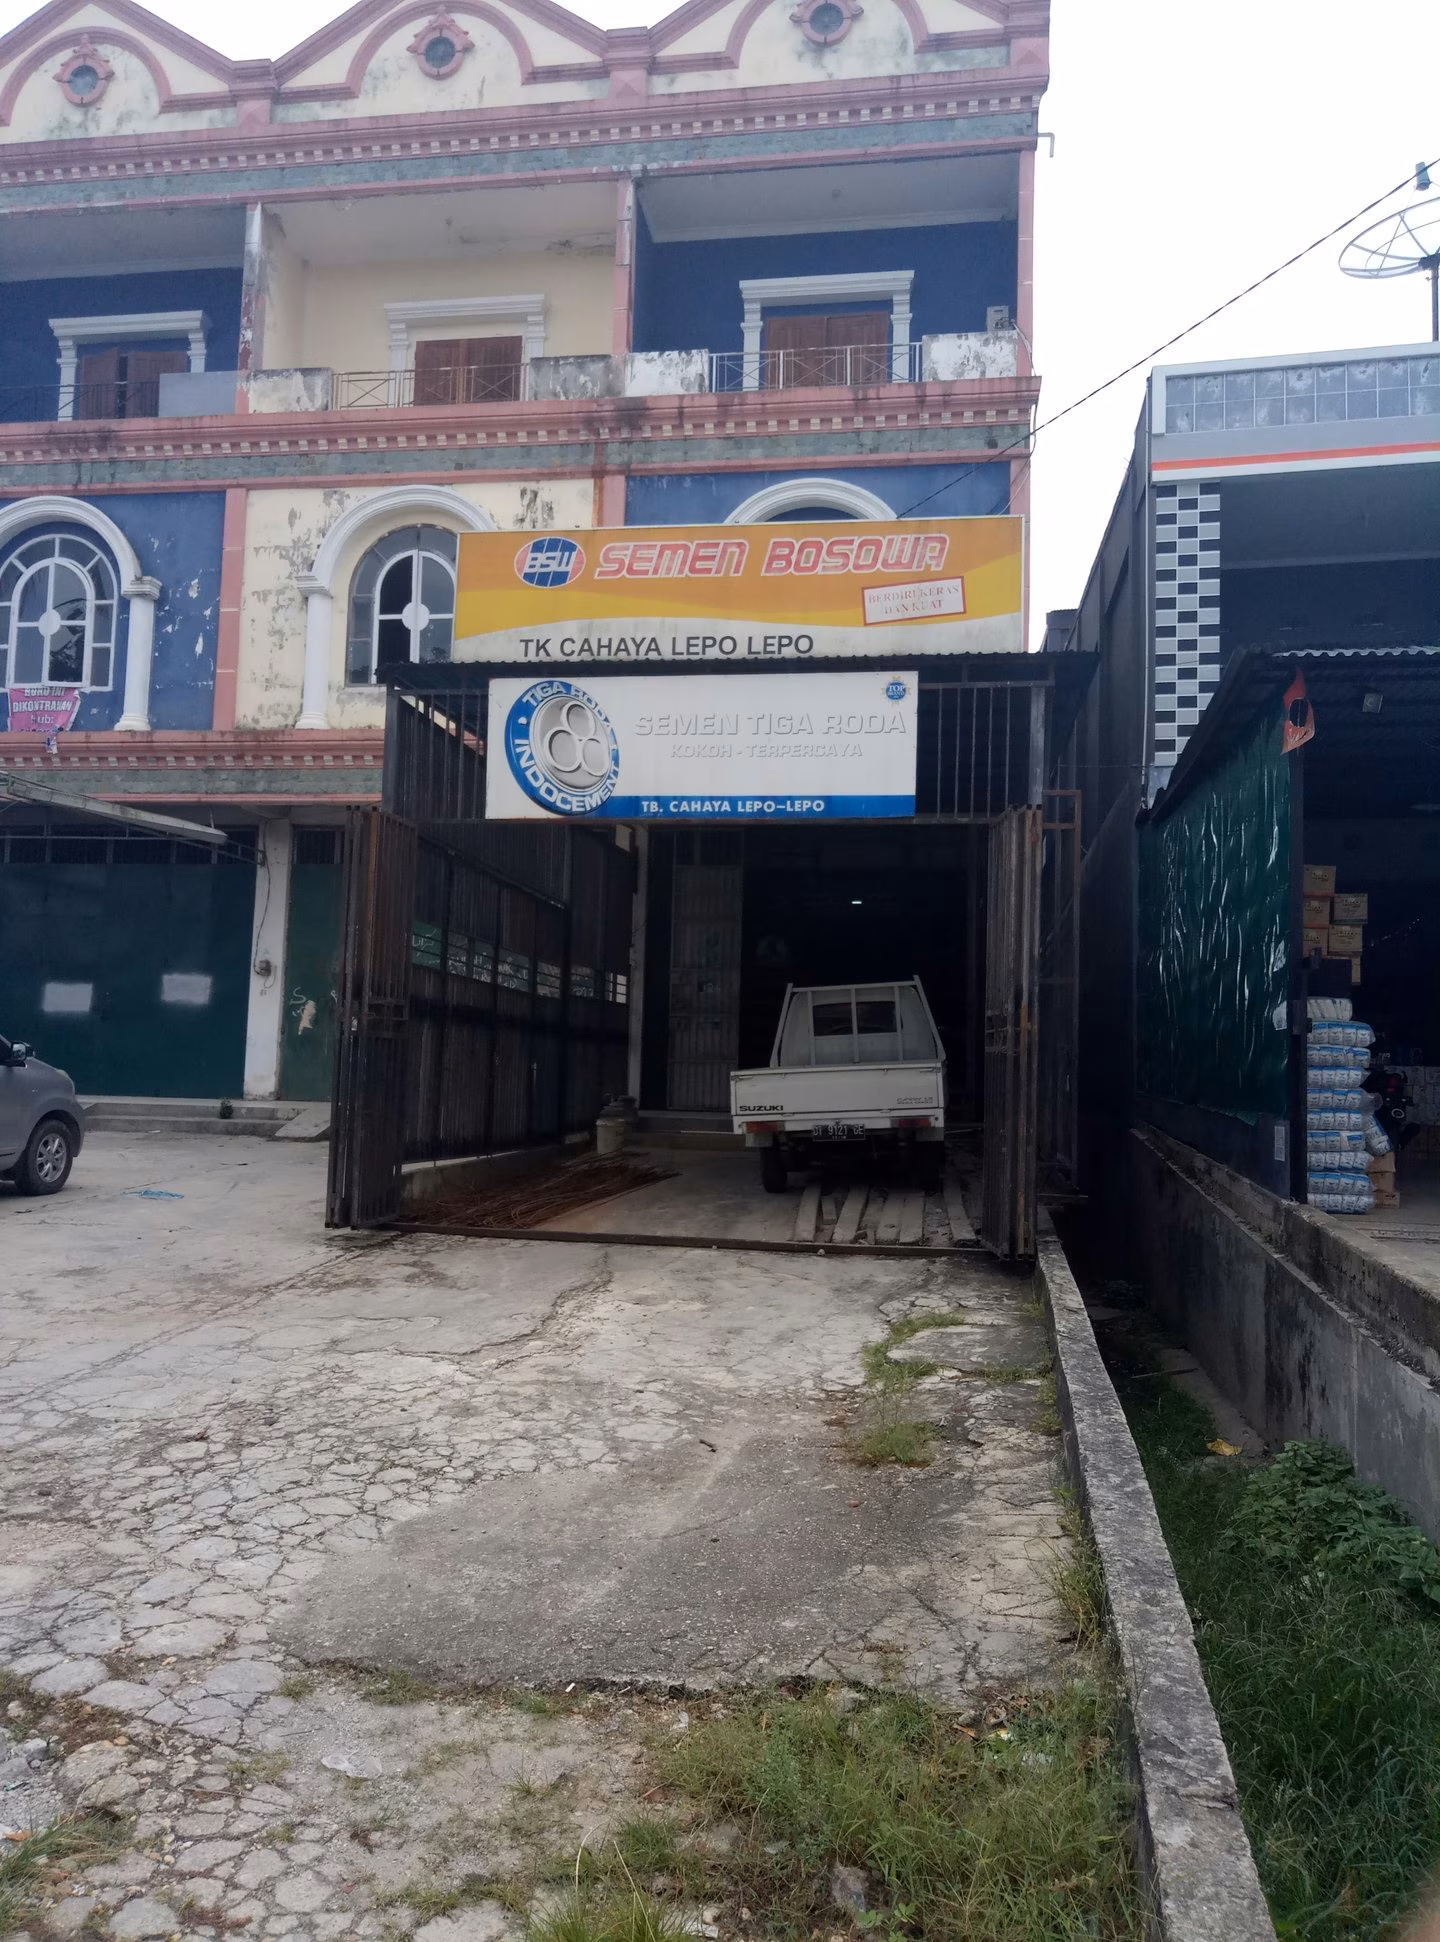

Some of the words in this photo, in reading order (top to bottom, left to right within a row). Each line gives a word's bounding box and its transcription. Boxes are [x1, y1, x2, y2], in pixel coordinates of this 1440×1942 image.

[594, 539, 750, 580] SEMEN
[761, 533, 950, 576] BOSOWA
[520, 638, 552, 658] TK
[560, 636, 662, 657] CAHAYA
[671, 636, 737, 656] LEPO
[747, 634, 814, 655] LEPO
[522, 681, 567, 707] TIGA
[634, 713, 738, 736] SEMEN
[746, 713, 814, 735] TIGA
[822, 712, 907, 734] RODA
[670, 744, 732, 758] KOKOH
[514, 738, 620, 812] INDOCEMENT
[641, 801, 664, 813] TB.
[669, 800, 731, 813] CAHAYA
[827, 1124, 848, 1136] 9121
